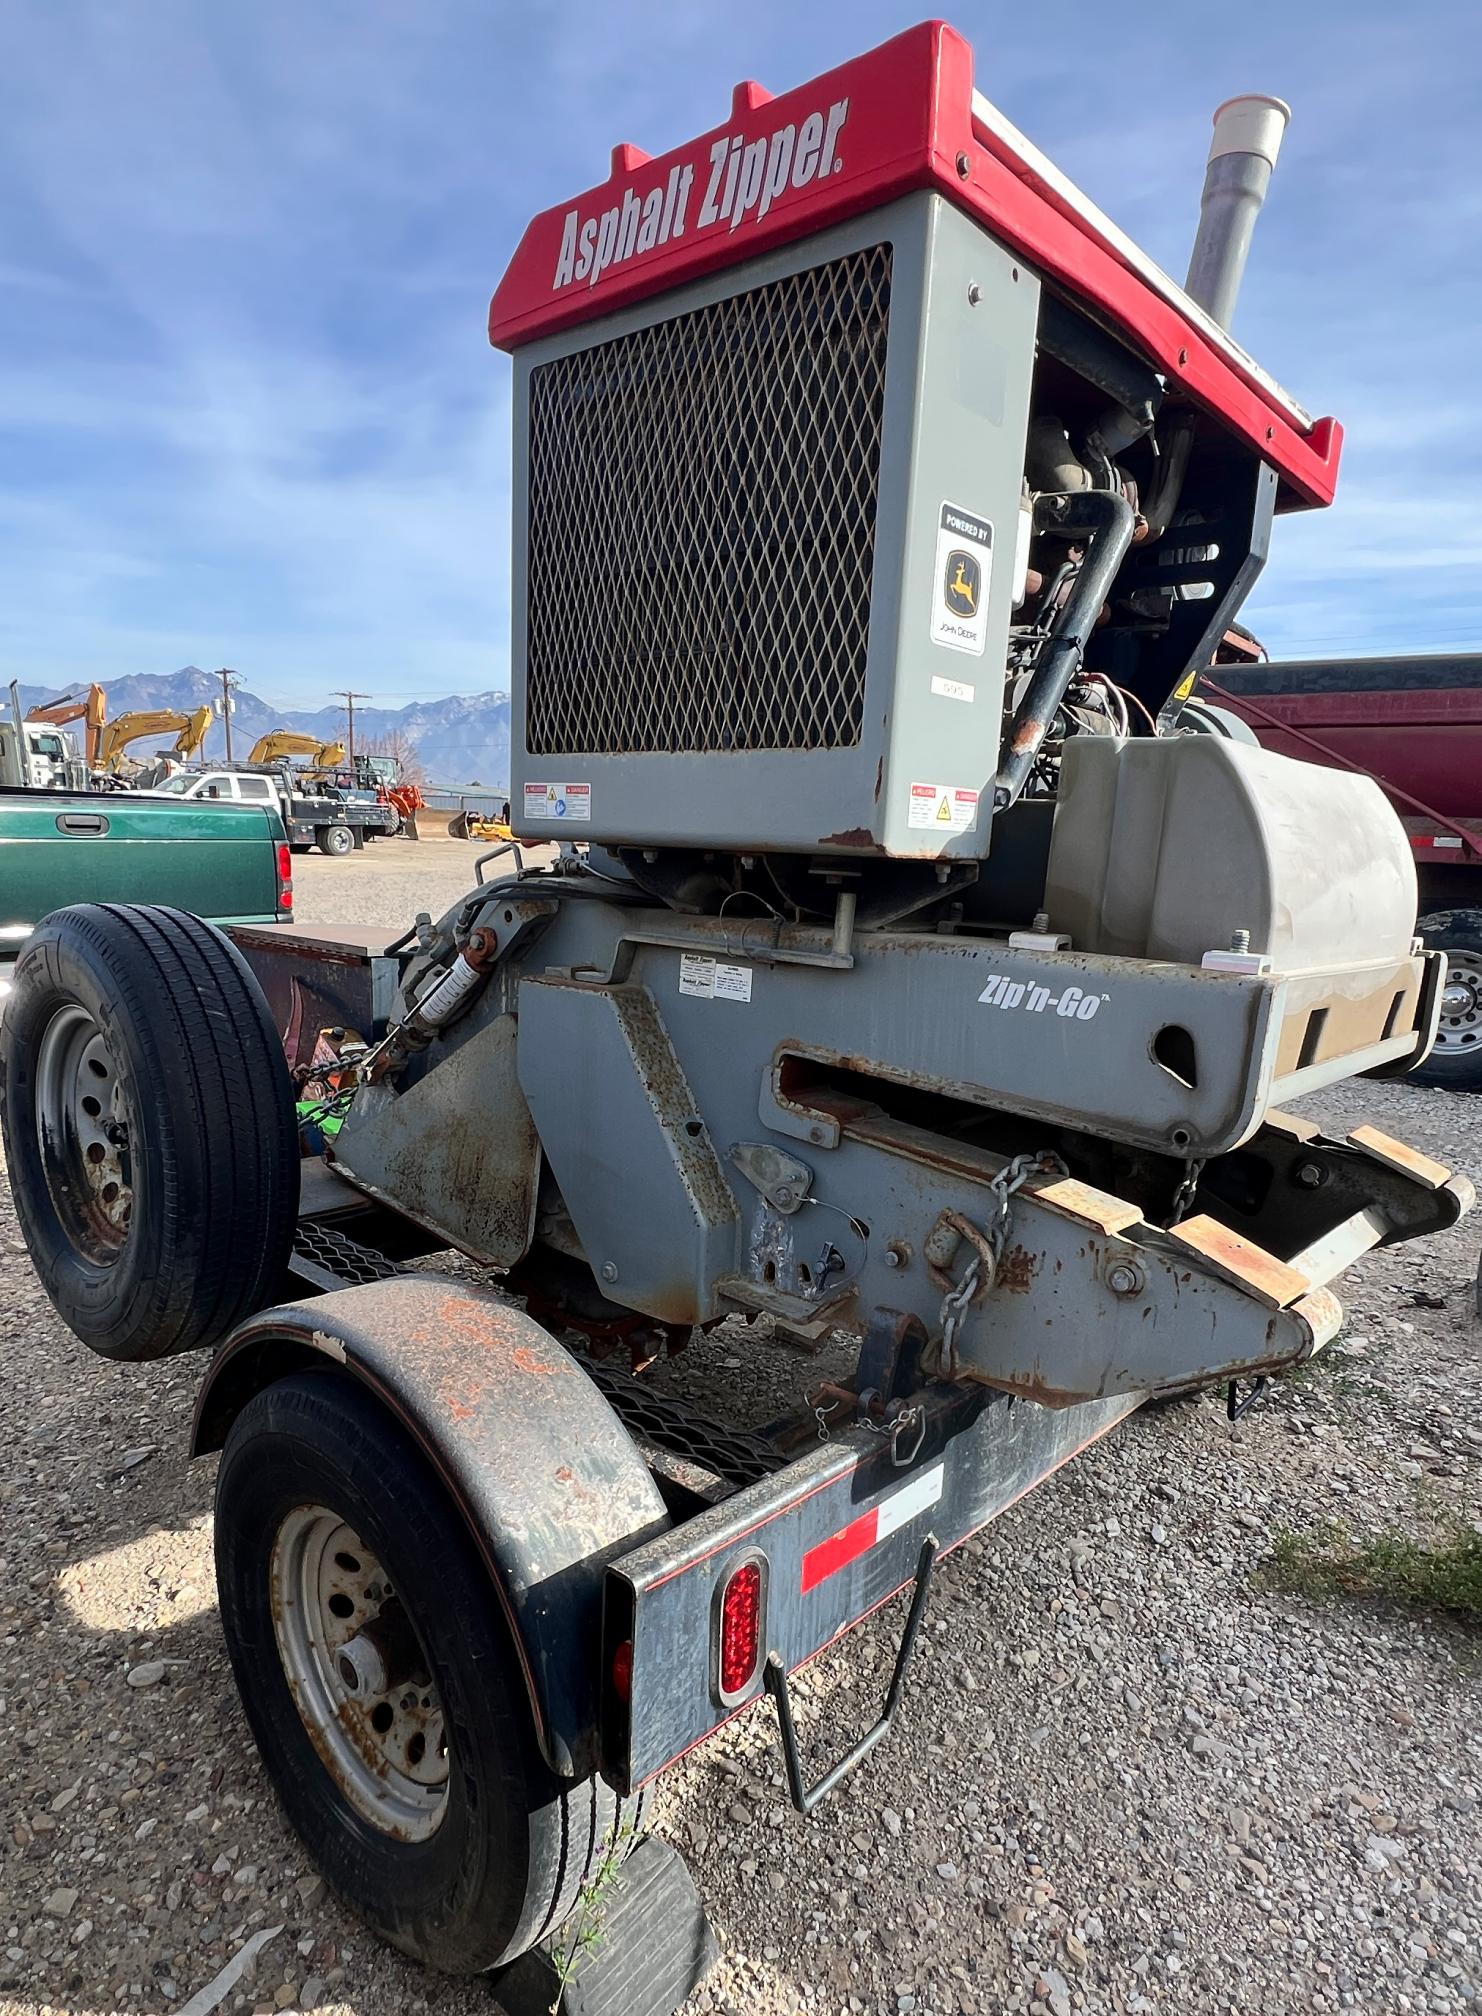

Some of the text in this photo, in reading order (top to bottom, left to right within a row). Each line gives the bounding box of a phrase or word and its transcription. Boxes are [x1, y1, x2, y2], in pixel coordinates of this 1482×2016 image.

[553, 163, 694, 290] Asphalt
[946, 514, 988, 541] POWERED BY
[940, 622, 957, 635] JOHN
